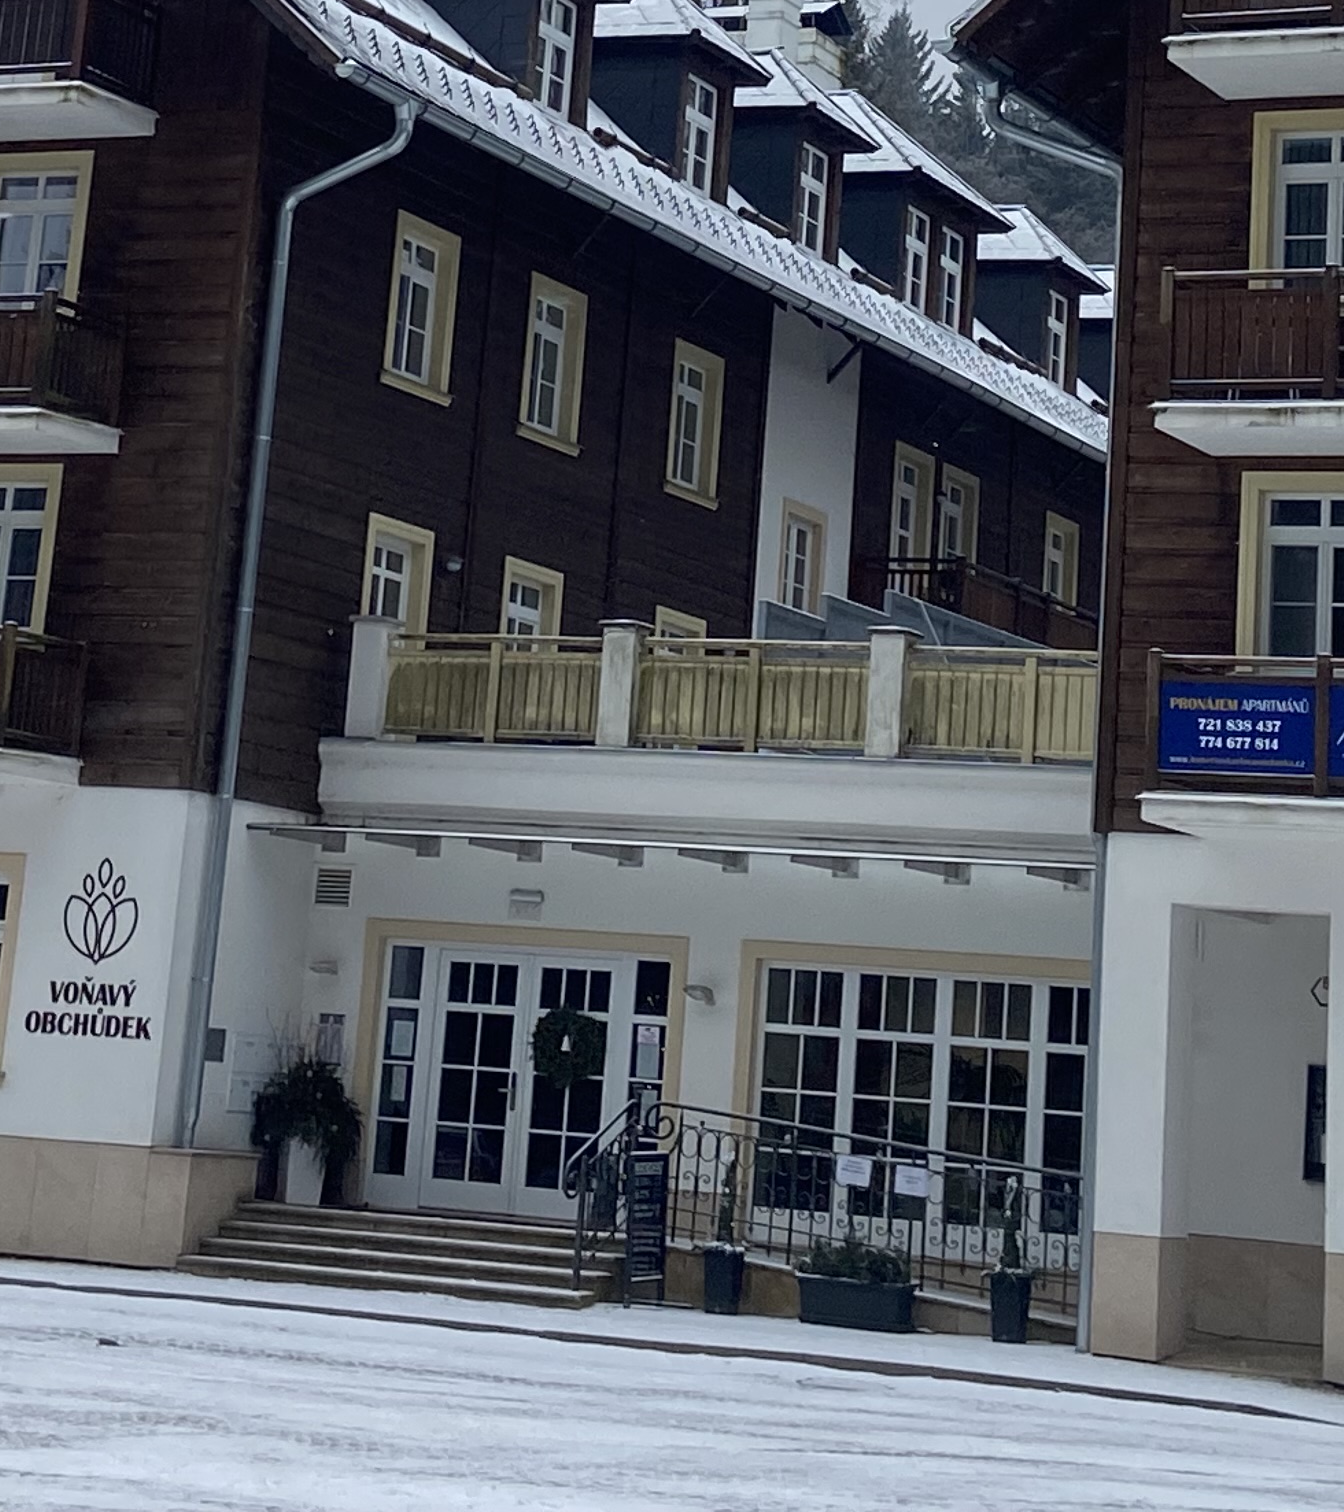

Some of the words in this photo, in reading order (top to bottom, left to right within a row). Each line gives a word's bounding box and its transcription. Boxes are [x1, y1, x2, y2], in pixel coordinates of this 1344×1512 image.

[1169, 695, 1238, 710] PRONÁJEM
[1241, 697, 1311, 714] APARTMÁNŮ
[1198, 718, 1221, 731] 721
[1225, 719, 1253, 732] 838
[1256, 720, 1282, 733] 437
[1199, 736, 1223, 748] 774
[1226, 736, 1251, 749] 677
[1254, 737, 1279, 750] 814
[50, 976, 137, 1007] VOŇAVÝ
[25, 1007, 152, 1040] OBCHŮDEK
